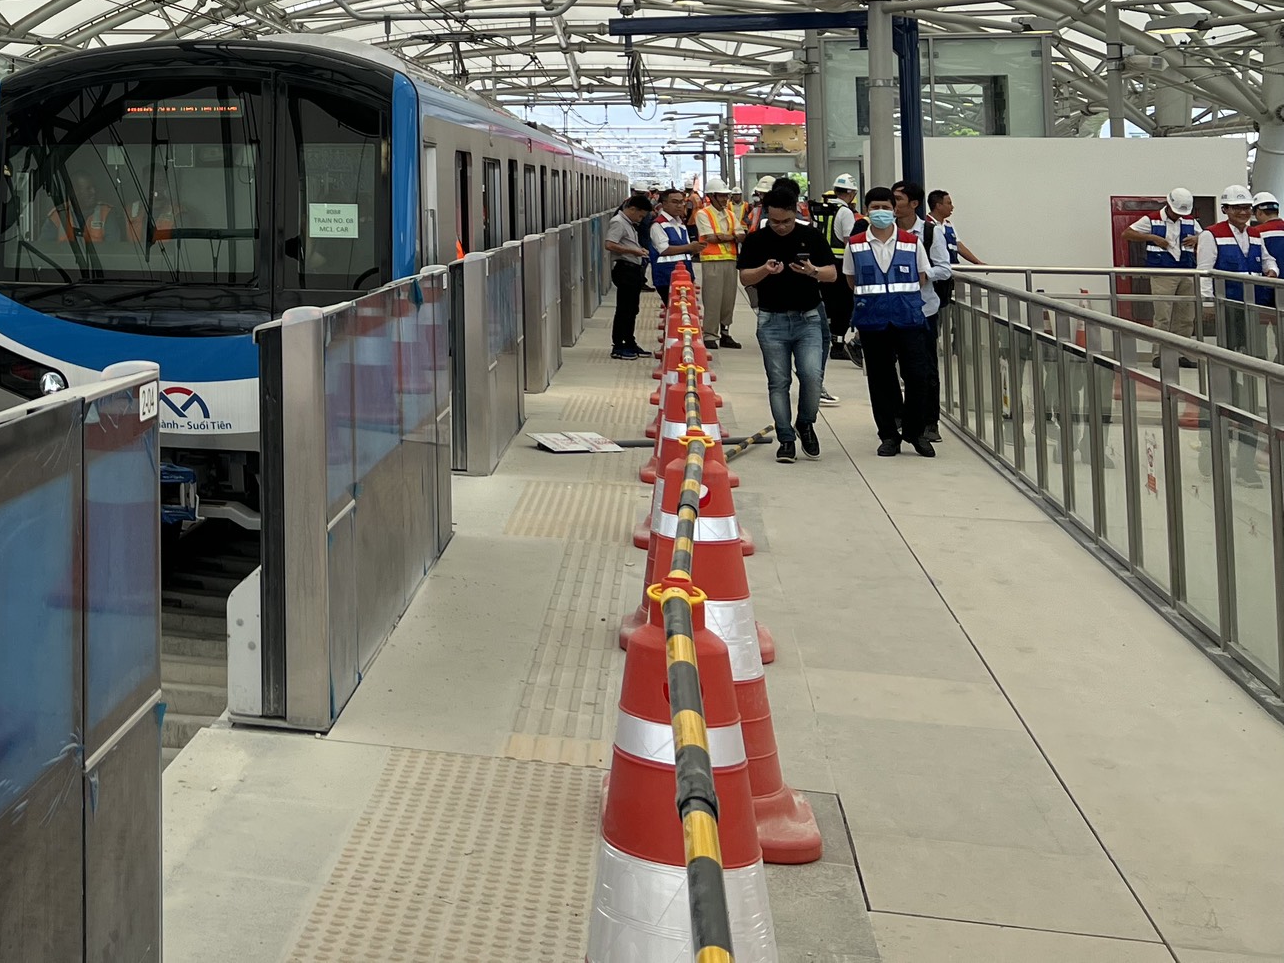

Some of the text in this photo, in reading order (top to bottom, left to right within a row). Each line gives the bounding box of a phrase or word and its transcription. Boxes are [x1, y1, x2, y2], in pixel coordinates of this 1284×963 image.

[142, 387, 155, 416] 2-04
[187, 420, 209, 430] Suối
[210, 421, 232, 430] Tiên
